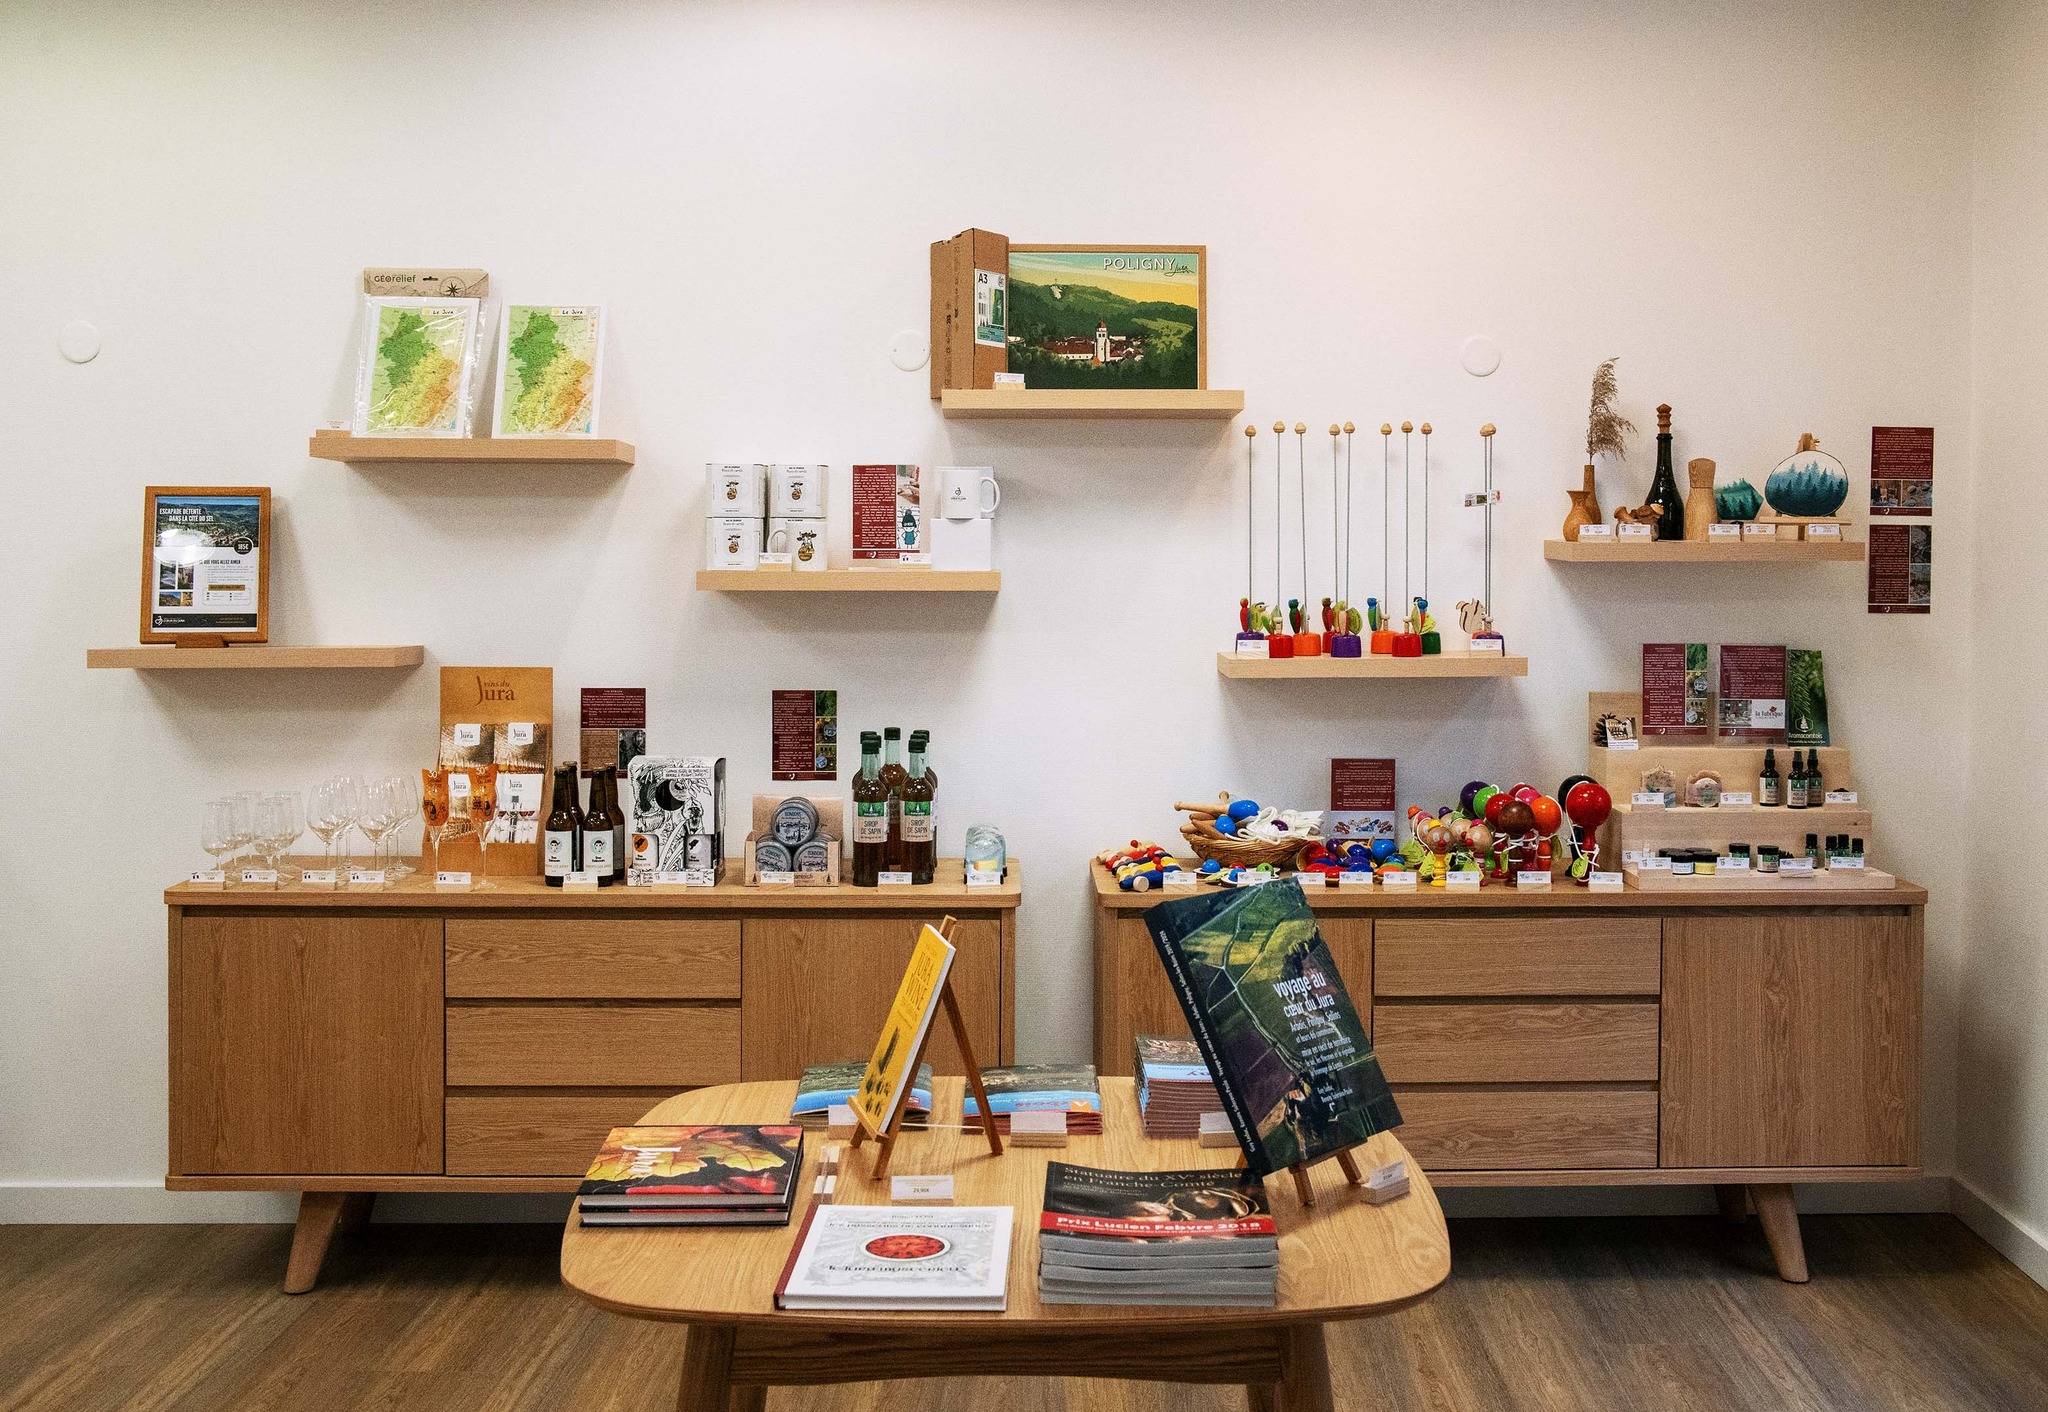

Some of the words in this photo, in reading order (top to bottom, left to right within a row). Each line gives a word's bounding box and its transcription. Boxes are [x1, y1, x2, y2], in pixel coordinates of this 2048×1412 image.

[1103, 257, 1176, 270] POLIGNY
[978, 273, 988, 284] A3
[500, 680, 510, 688] du
[474, 675, 516, 707] Jura
[460, 730, 474, 740] Jura
[513, 728, 527, 739] Jura
[453, 780, 467, 790] Jura
[509, 780, 523, 789] Jura
[863, 820, 879, 828] SIROP
[906, 826, 912, 834] DE
[914, 826, 928, 834] SAPIN
[914, 952, 934, 986] JURA
[904, 973, 928, 1011] WINE
[1273, 976, 1312, 1000] voyage
[1311, 972, 1327, 988] au
[1283, 1001, 1305, 1018] cœur
[1304, 996, 1317, 1012] du
[1315, 994, 1335, 1009] Jura
[1064, 1166, 1135, 1181] Statuaire
[1138, 1173, 1159, 1182] du
[1200, 1171, 1243, 1180] siècle
[1064, 1174, 1078, 1183] en
[1089, 1176, 1216, 1189] Franche-Comté
[1057, 1217, 1090, 1226] Prix
[1094, 1220, 1150, 1231] Lucien
[1154, 1222, 1213, 1231] Febvre
